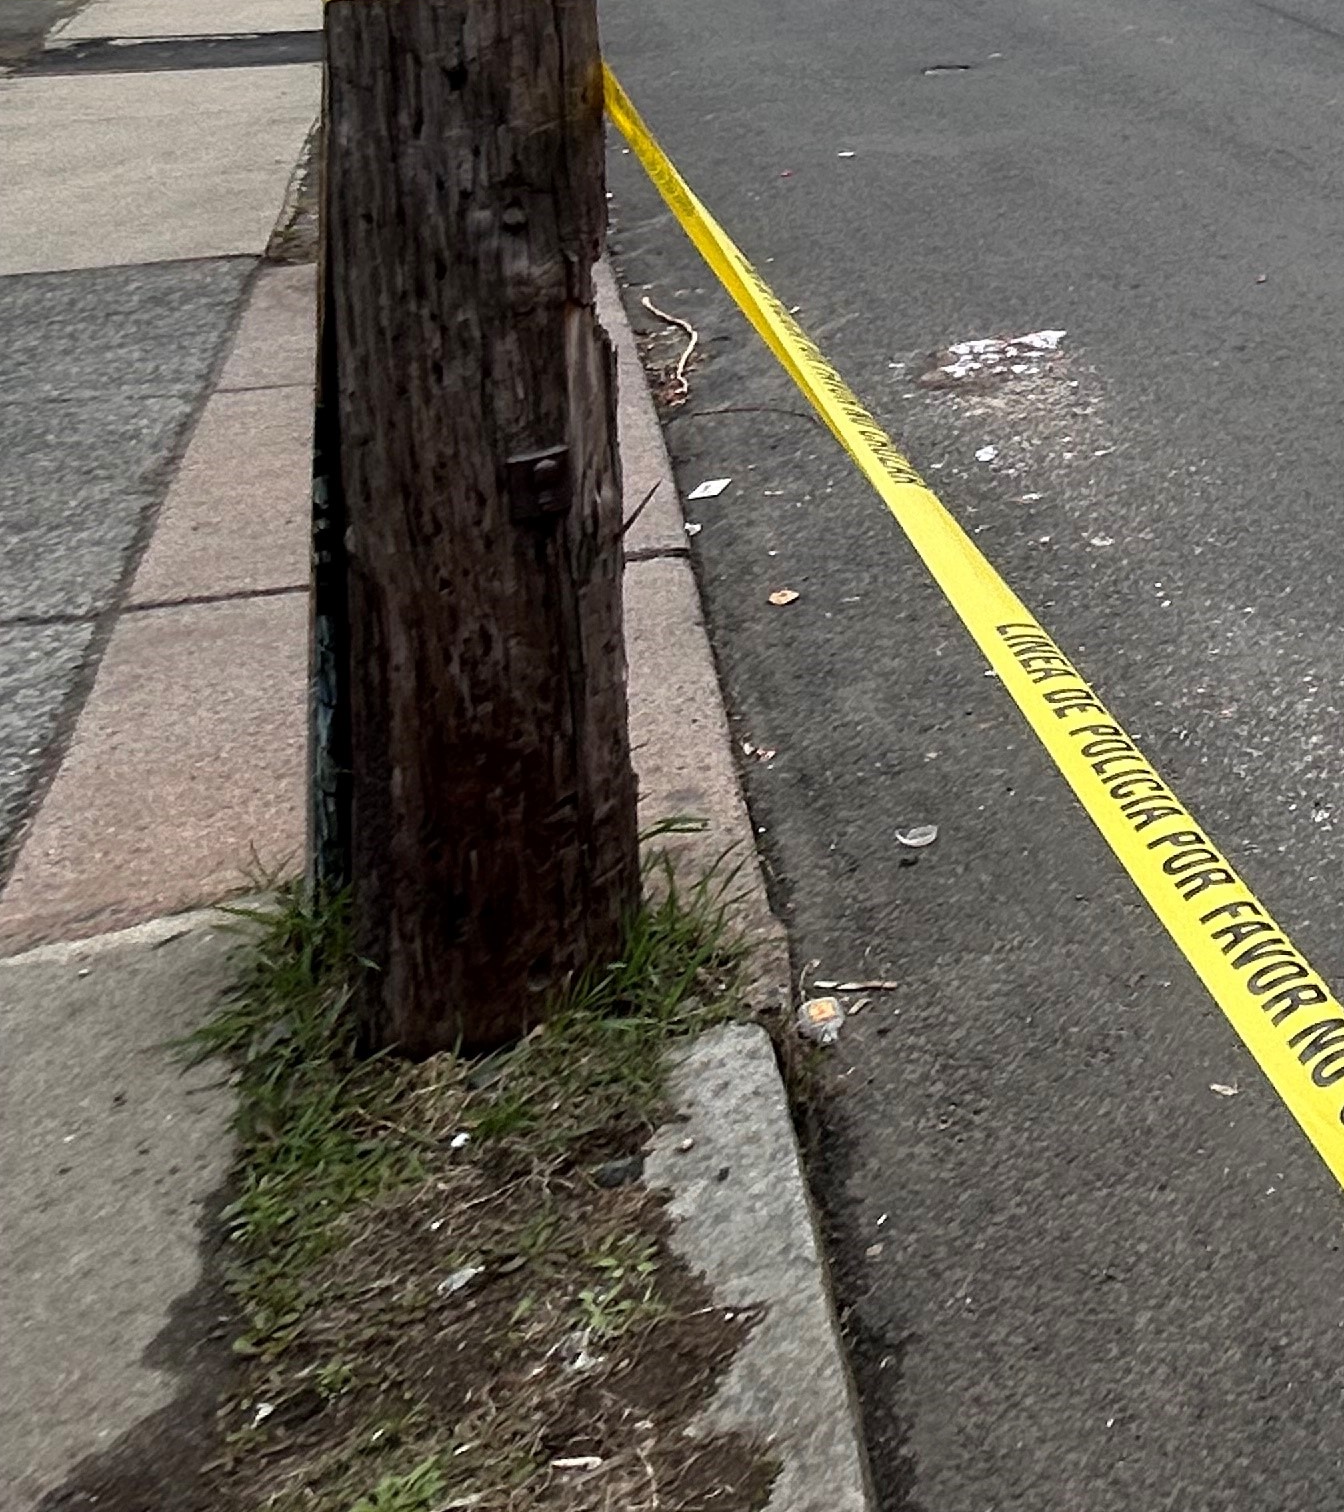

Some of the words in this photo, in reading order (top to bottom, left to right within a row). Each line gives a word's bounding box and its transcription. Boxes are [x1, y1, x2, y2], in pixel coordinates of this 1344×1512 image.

[996, 622, 1078, 684] LINEA
[1042, 688, 1107, 720] DE
[1069, 724, 1184, 832] POLICIA
[1147, 830, 1236, 902] POR
[1199, 900, 1328, 1027] FAVOR
